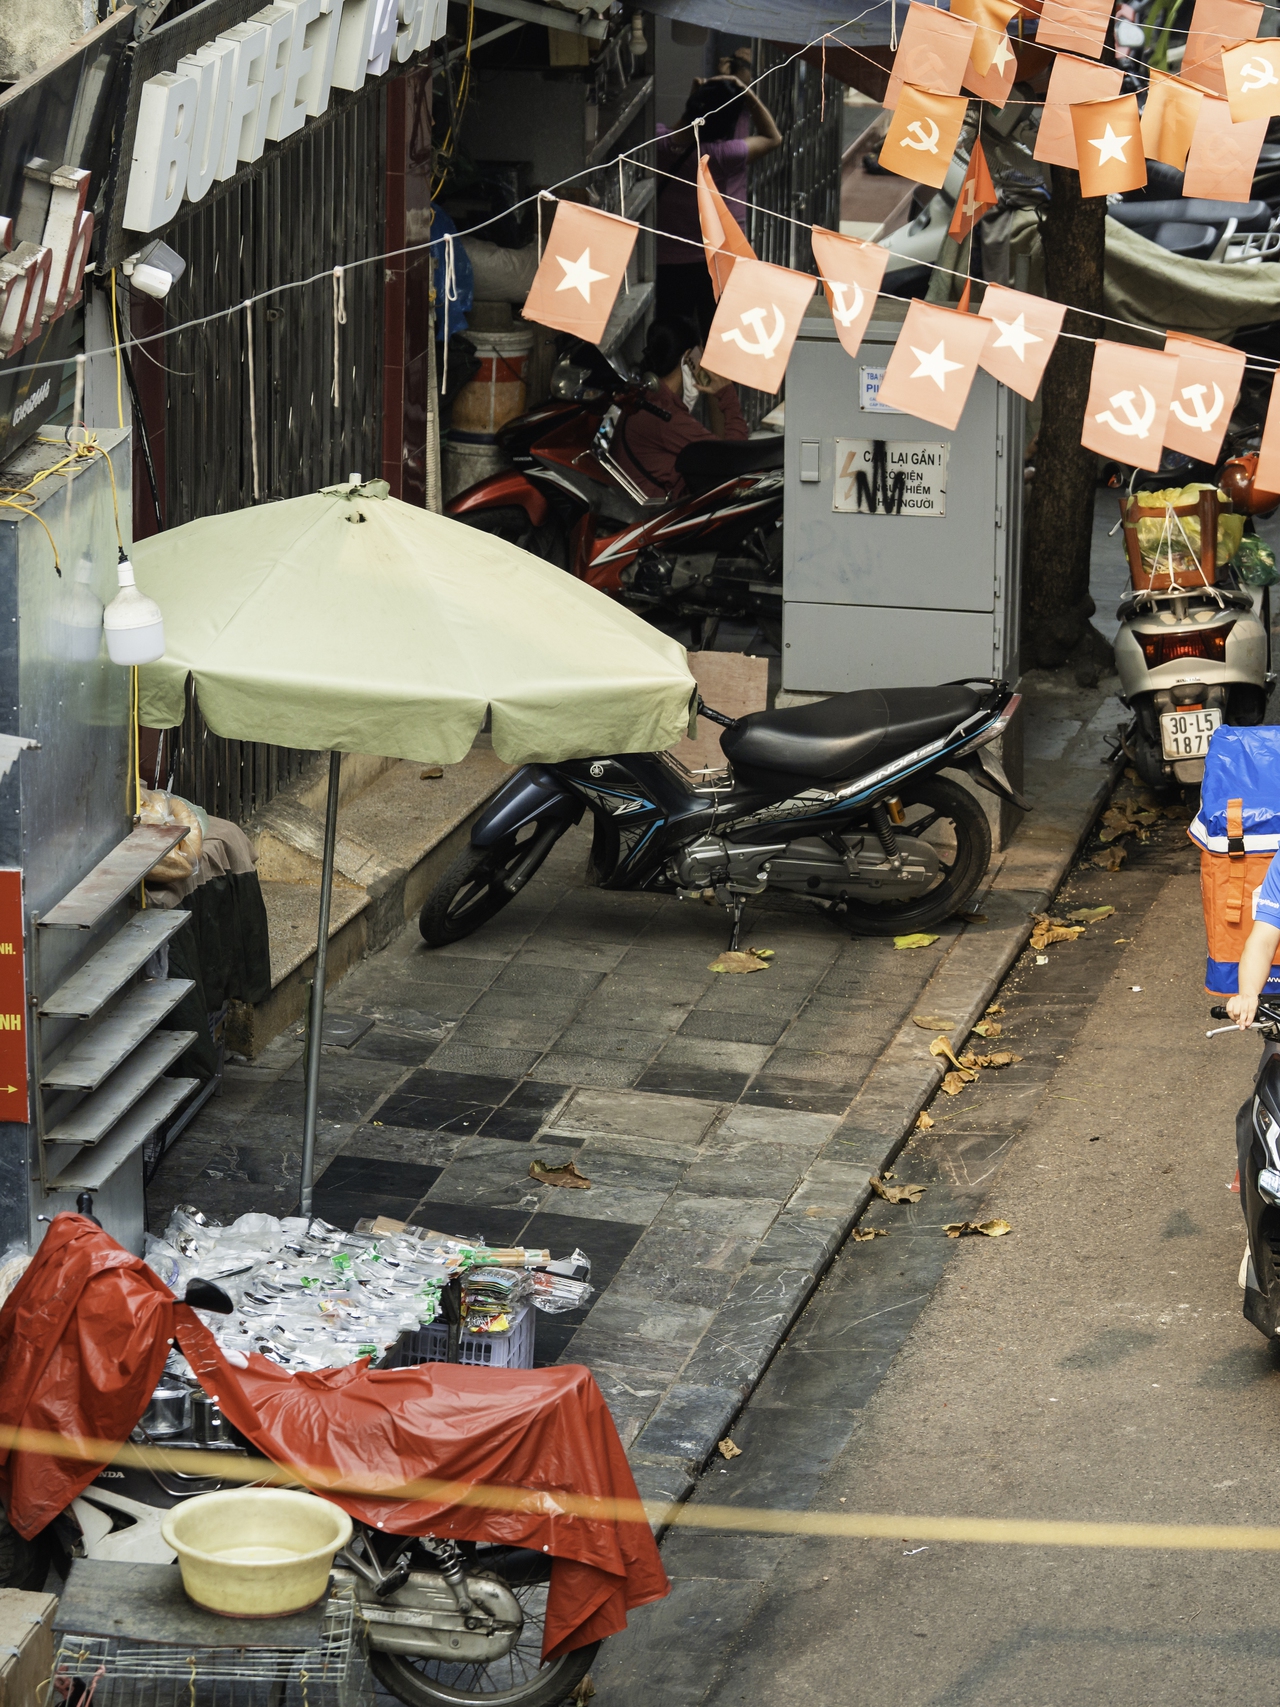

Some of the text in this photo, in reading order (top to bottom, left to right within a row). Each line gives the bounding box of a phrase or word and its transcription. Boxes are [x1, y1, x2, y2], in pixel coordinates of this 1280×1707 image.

[122, 0, 345, 233] BUFFET
[890, 451, 908, 468] LẠI
[1170, 713, 1213, 735] 30-L5
